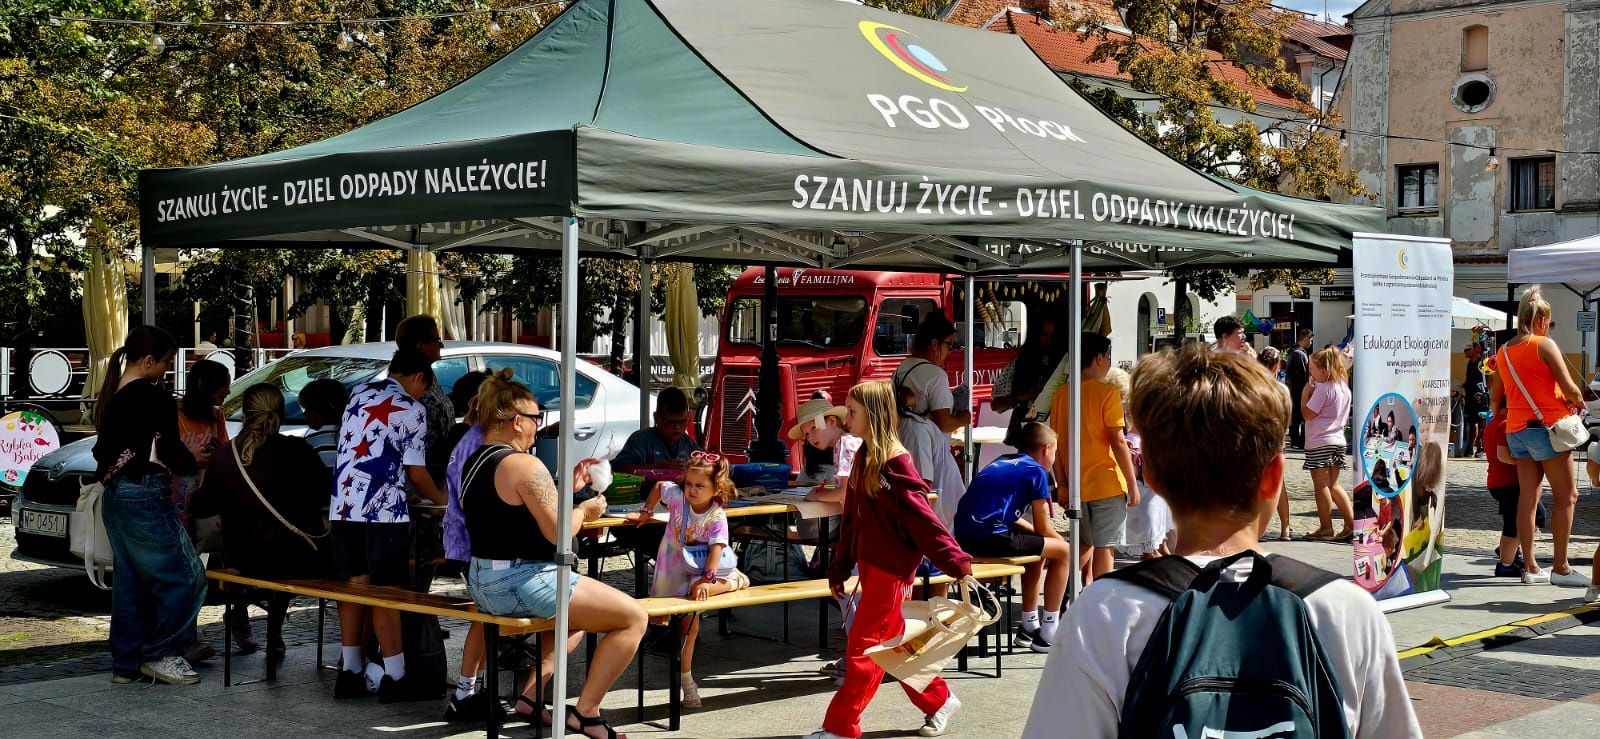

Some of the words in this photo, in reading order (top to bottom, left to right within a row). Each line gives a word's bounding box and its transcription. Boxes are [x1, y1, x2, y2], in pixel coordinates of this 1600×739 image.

[866, 93, 970, 130] PGO
[974, 104, 1088, 144] Płock
[157, 192, 217, 223] SZANUJ
[220, 184, 268, 214] ŻYCIE
[283, 176, 336, 206] DZIEL
[340, 169, 418, 200] ODPADY
[425, 158, 547, 195] NALEŻYCIE!
[791, 174, 908, 213] SZANUJ
[915, 175, 994, 216] ŻYCIE
[998, 201, 1008, 209] -
[1016, 187, 1085, 220] DZIEL
[1092, 192, 1183, 229] ODPADY
[1187, 202, 1295, 240] NALEŻYCIE!
[800, 275, 854, 286] FAMILIJNA
[1363, 335, 1402, 356] Edukacja
[1403, 335, 1449, 356] Ekologiczna
